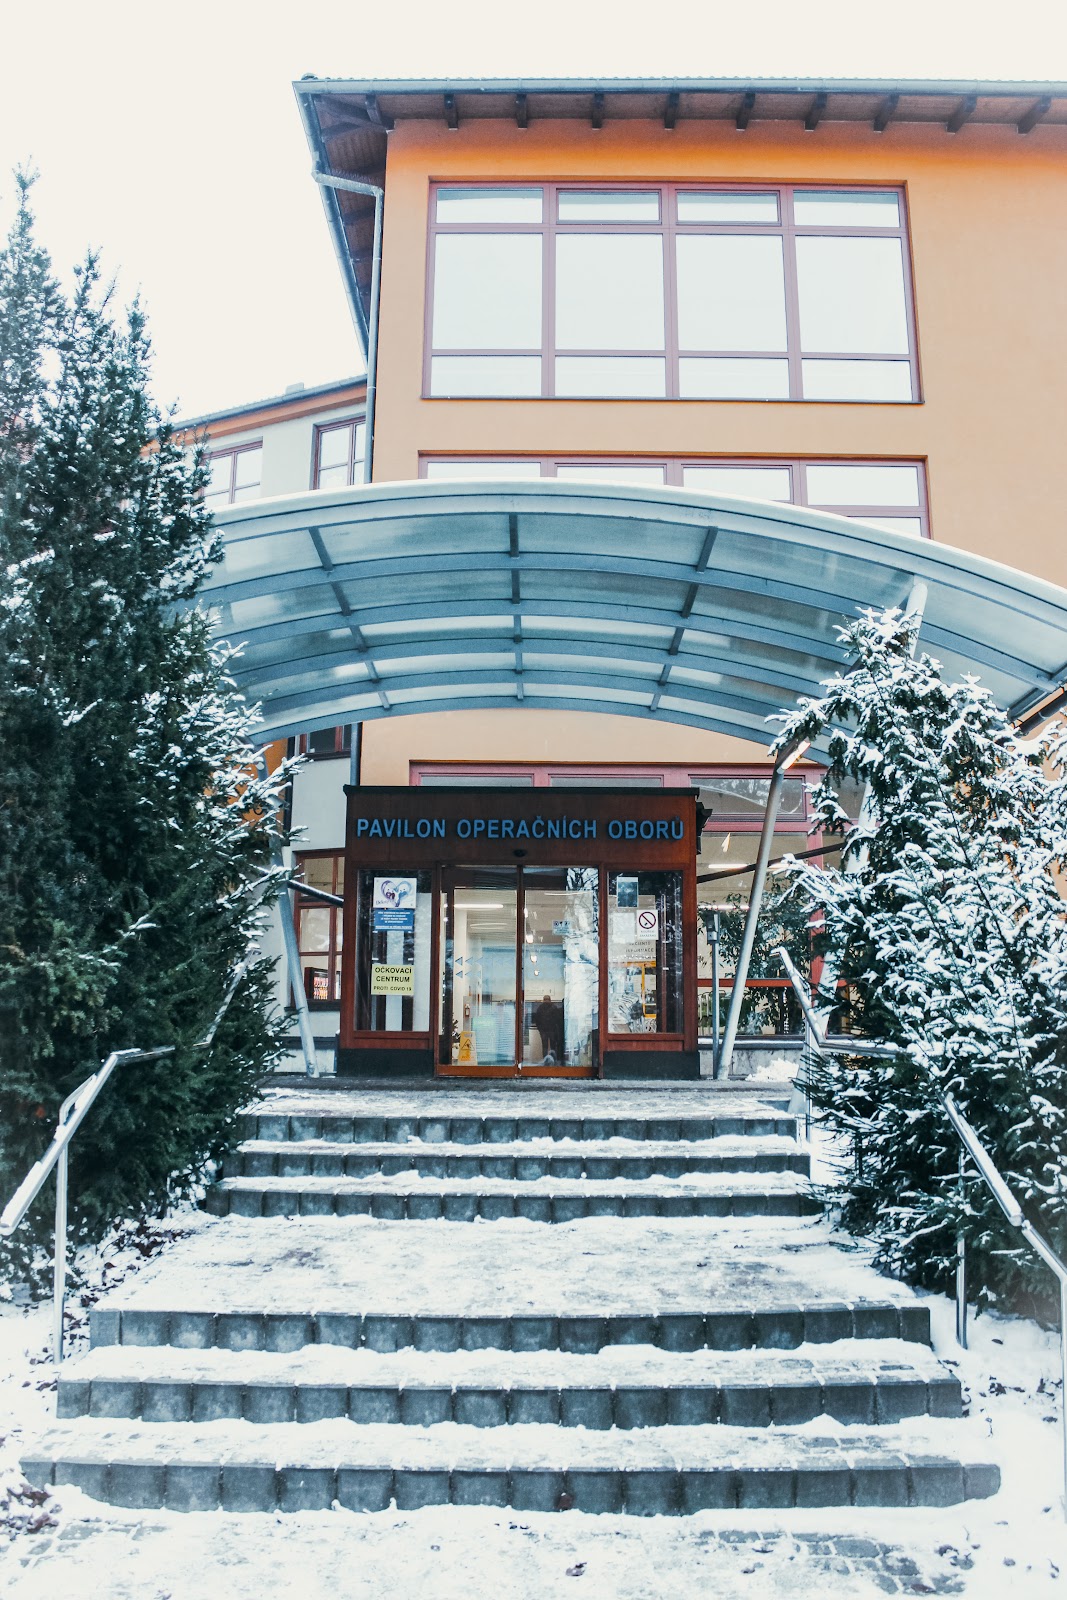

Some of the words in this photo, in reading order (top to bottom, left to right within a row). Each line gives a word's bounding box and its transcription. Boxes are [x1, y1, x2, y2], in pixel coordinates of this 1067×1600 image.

[357, 818, 445, 838] PAVILON
[457, 815, 597, 839] OPERAČNÍCH
[608, 815, 684, 840] OBORŮ
[376, 975, 410, 983] CENTRUM
